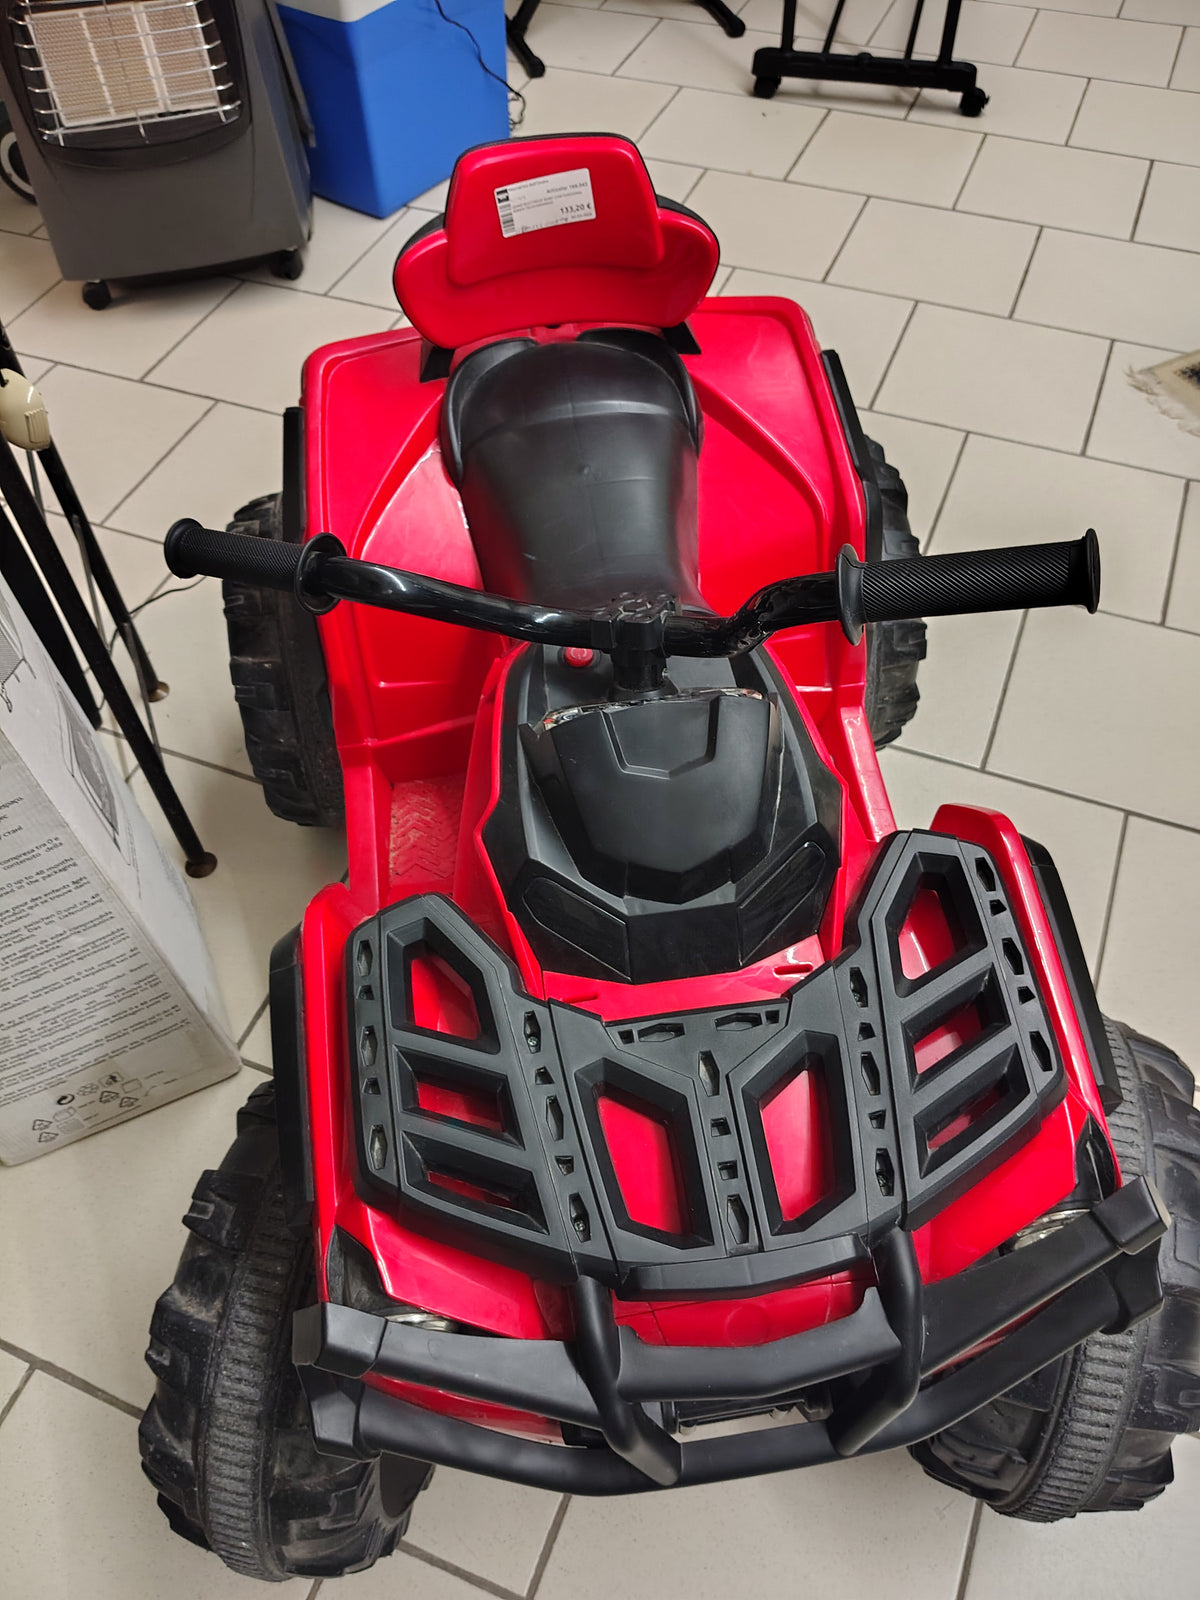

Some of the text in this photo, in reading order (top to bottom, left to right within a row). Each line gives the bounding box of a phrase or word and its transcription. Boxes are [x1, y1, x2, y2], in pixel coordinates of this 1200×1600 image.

[560, 204, 585, 214] 133,20
[0, 849, 36, 866] compresa
[2, 842, 64, 870] contenuto della
[46, 857, 74, 872] months
[25, 878, 40, 886] the
[39, 862, 78, 881] packaging
